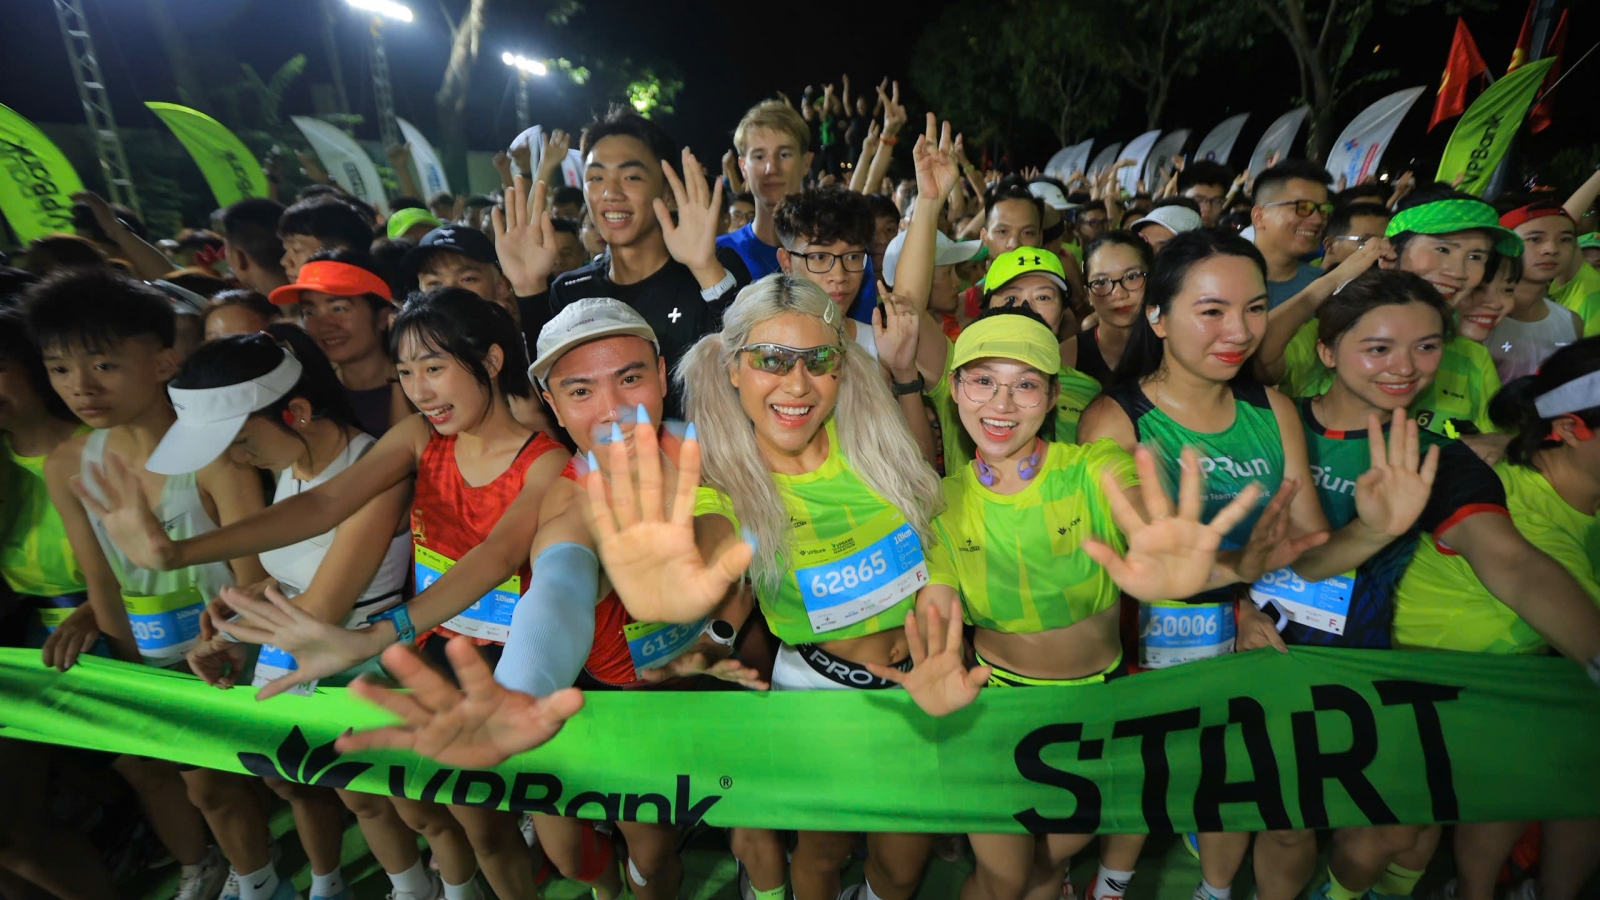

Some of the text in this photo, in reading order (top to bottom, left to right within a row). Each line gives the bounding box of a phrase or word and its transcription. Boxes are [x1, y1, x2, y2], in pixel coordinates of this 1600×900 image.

[1462, 113, 1504, 185] VPBank
[894, 529, 913, 545] 10km
[807, 548, 827, 556] VPBank
[810, 550, 888, 598] 62865
[916, 570, 923, 582] F
[495, 594, 516, 604] 10km
[1328, 618, 1338, 628] F
[809, 649, 874, 685] PRO
[298, 680, 312, 692] M
[1013, 680, 1464, 834] START
